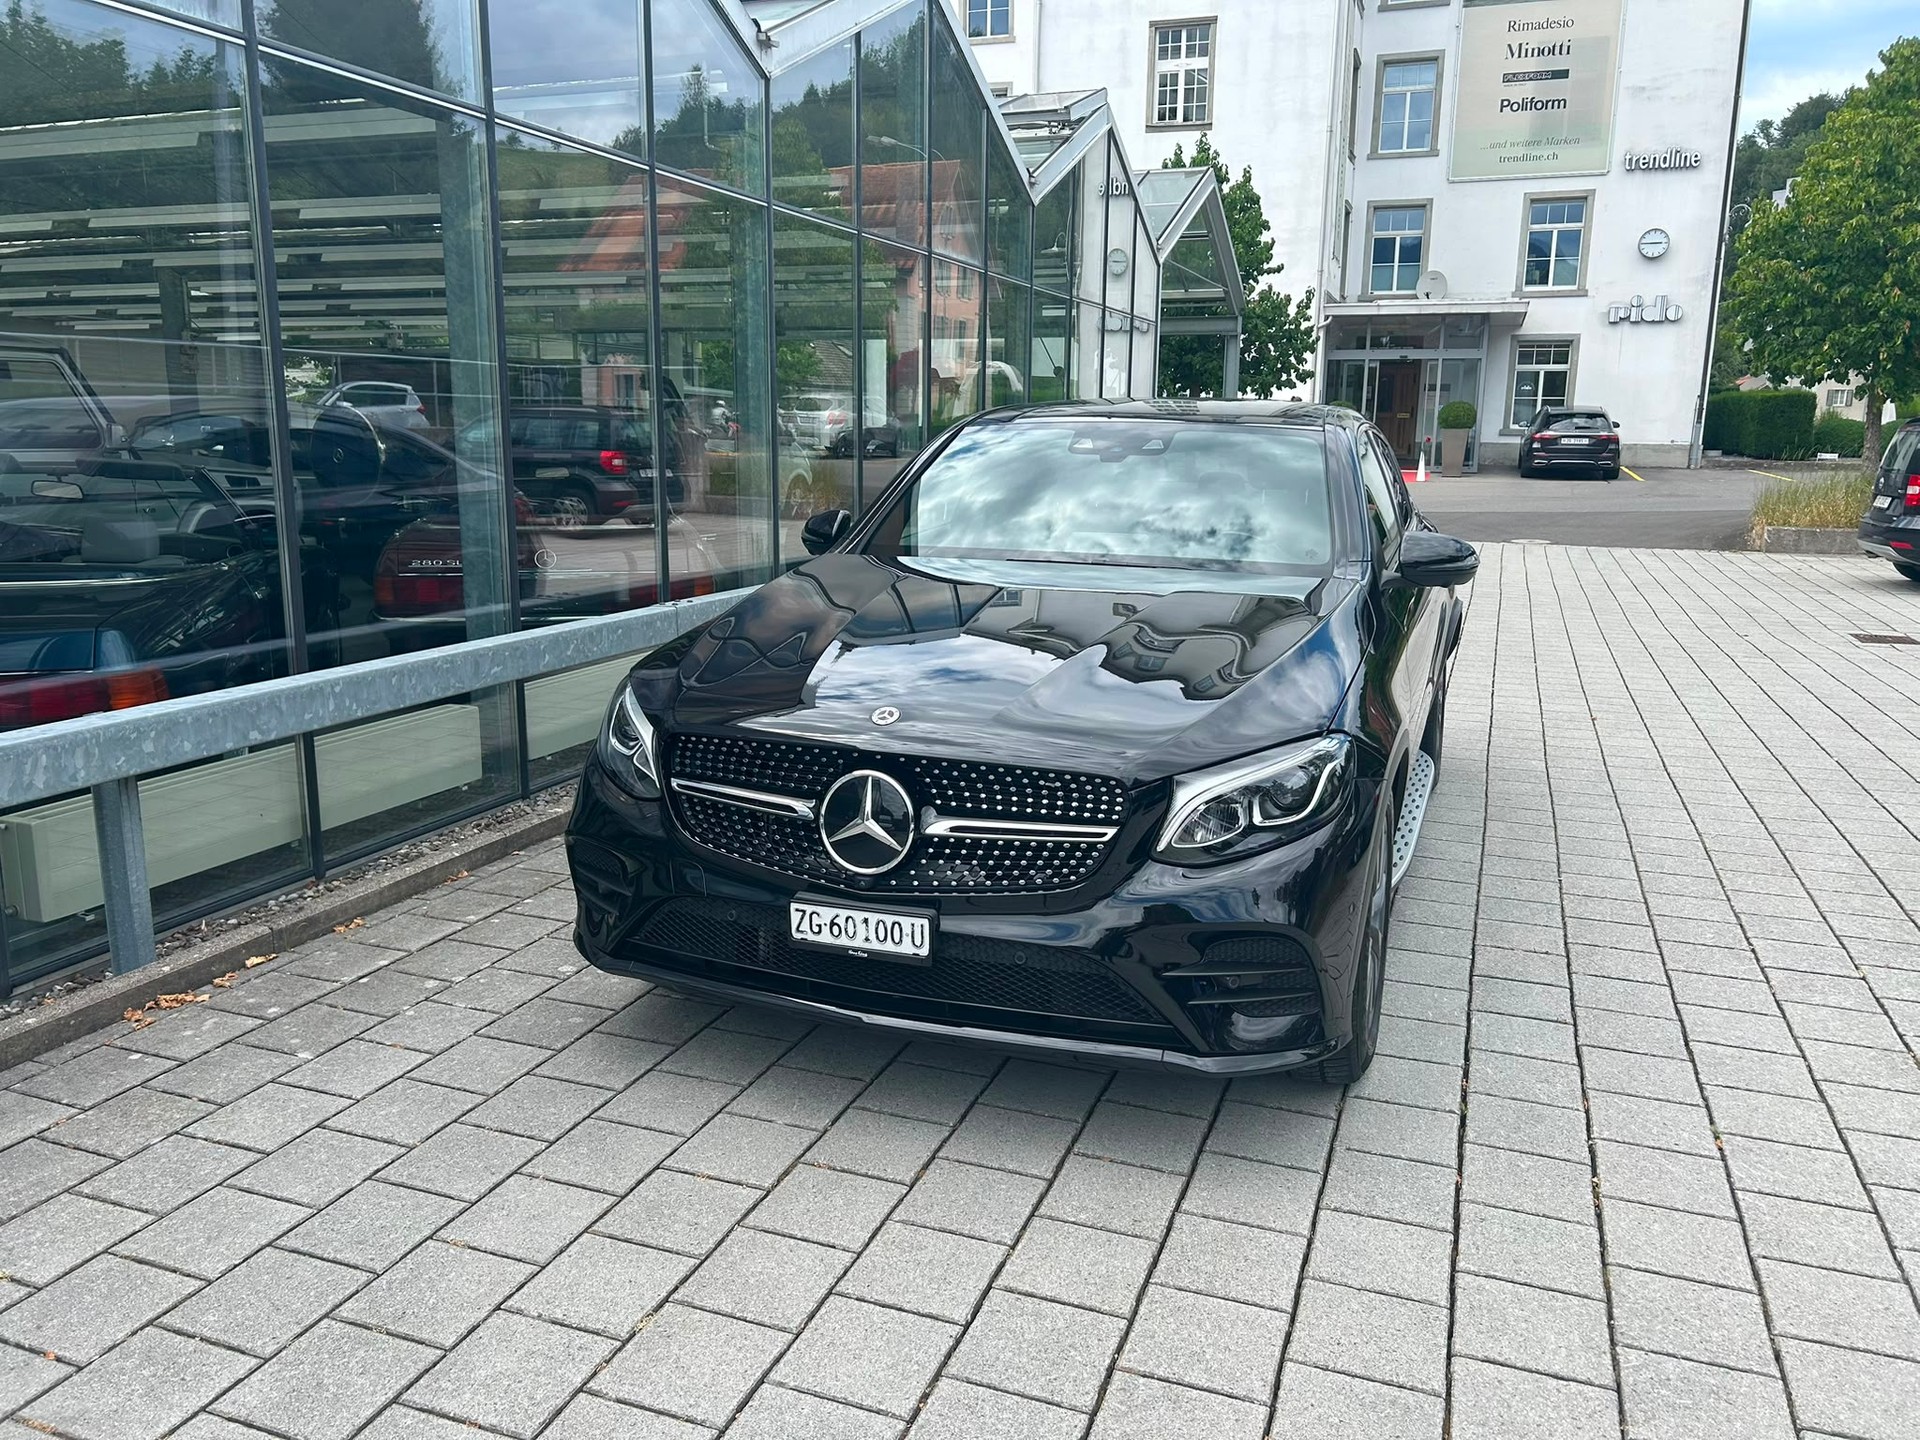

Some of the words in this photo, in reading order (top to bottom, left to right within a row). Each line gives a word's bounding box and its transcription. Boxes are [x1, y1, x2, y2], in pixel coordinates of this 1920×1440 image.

[1507, 15, 1575, 33] Rimadesio
[1504, 38, 1572, 60] Minotti
[1503, 71, 1552, 82] FLEXFORM
[1499, 96, 1567, 113] Poliform
[1509, 137, 1542, 148] weitere
[1543, 136, 1581, 147] Marken
[1498, 151, 1559, 164] trendline.ch
[1624, 146, 1702, 170] trendline
[411, 558, 443, 567] 280
